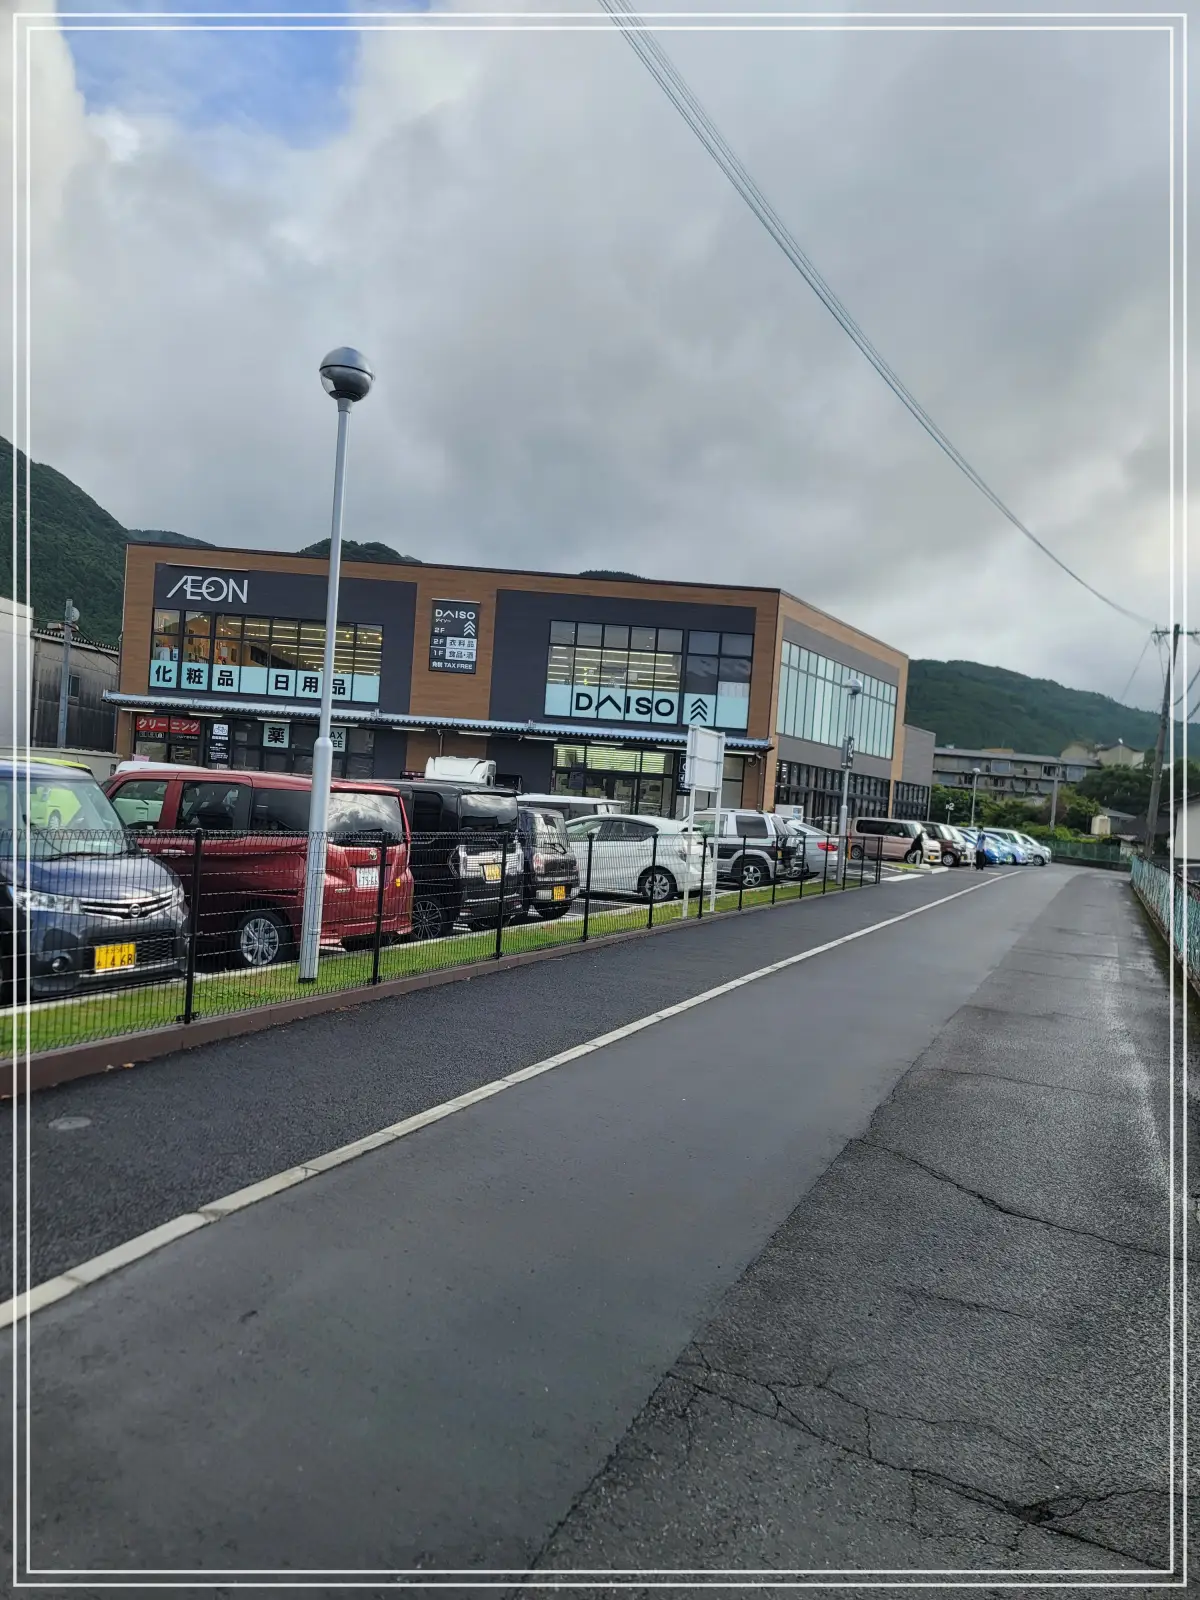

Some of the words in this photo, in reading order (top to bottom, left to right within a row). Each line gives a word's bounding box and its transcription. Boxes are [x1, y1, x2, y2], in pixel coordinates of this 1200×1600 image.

[435, 609, 476, 620] DAISO
[155, 665, 234, 688] 化粧品
[274, 674, 346, 696] 日用品
[575, 692, 674, 717] DAISO
[138, 718, 200, 732] クリーニング
[267, 726, 285, 744] 薬
